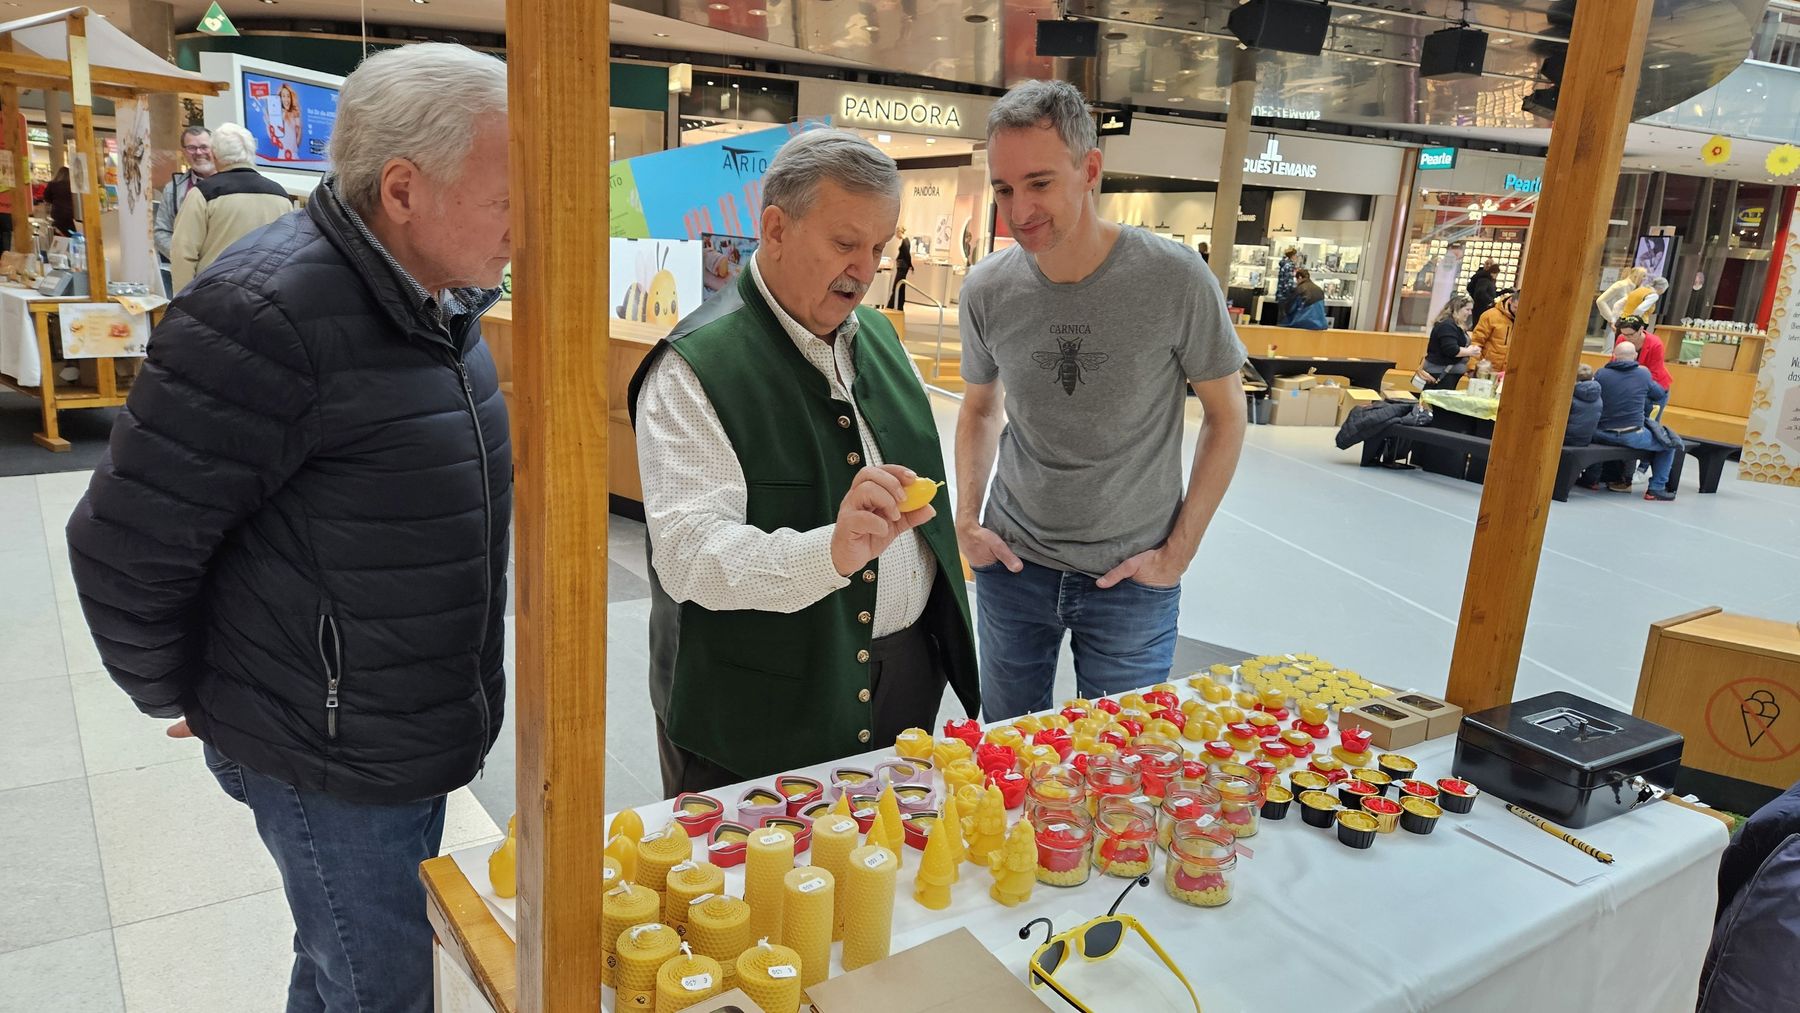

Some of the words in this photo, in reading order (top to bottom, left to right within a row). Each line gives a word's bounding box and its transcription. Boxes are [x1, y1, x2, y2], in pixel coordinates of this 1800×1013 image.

[845, 97, 960, 127] PANDORA
[721, 145, 769, 178] ATRIO
[1420, 152, 1453, 166] Pearle
[1272, 161, 1318, 178] LEMANS
[913, 185, 940, 197] PANDORA
[1049, 324, 1092, 335] CARNICA
